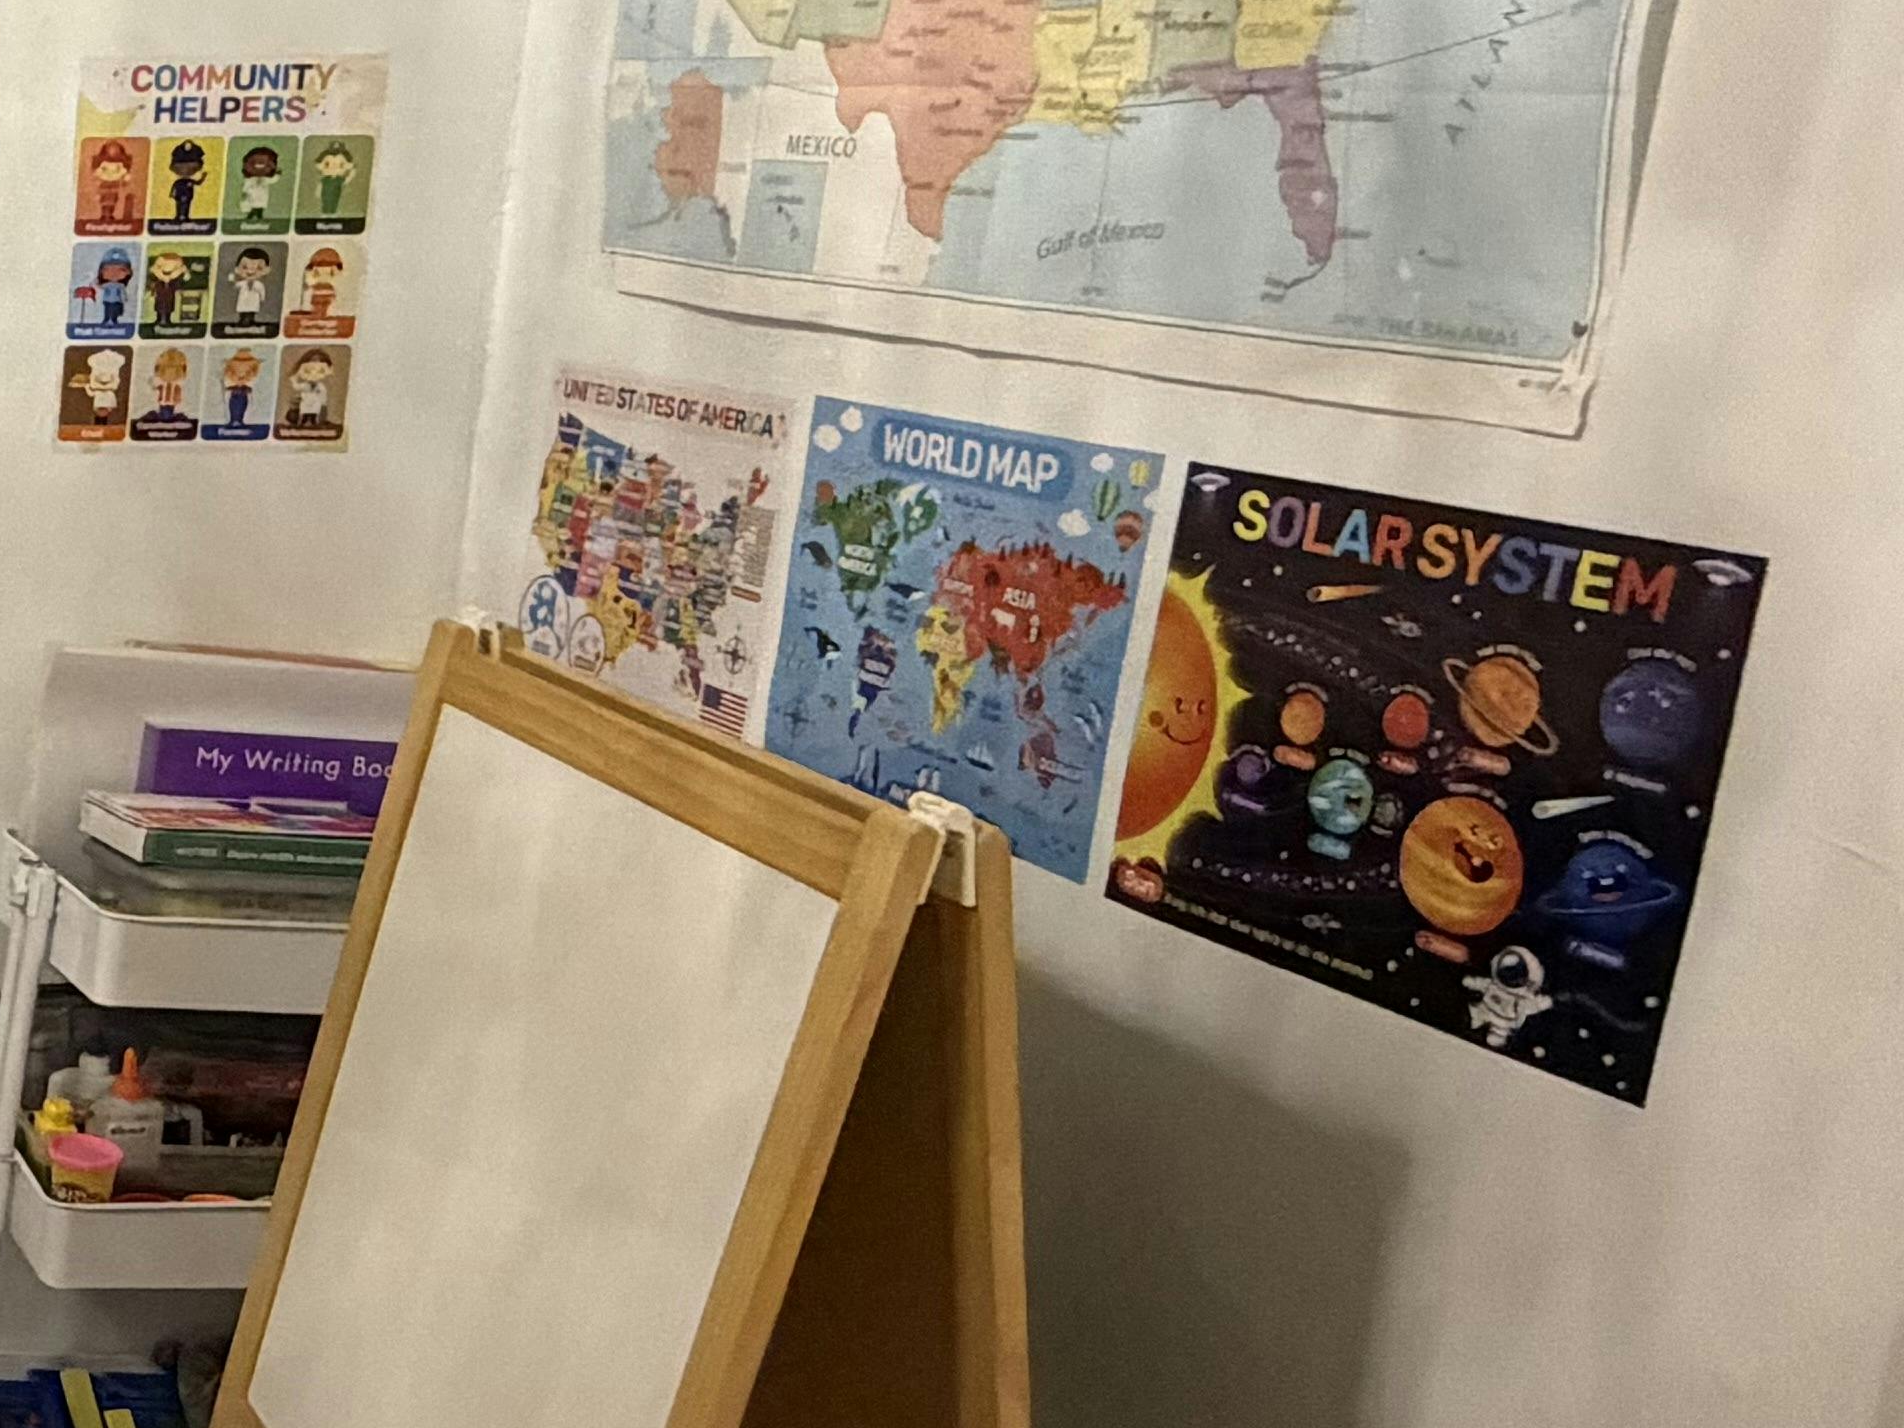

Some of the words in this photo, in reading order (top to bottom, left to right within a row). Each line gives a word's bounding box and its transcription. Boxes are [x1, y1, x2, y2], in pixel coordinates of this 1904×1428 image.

[131, 63, 337, 93] COMMUNITY
[154, 96, 307, 124] HELPERS
[786, 134, 858, 158] MEXICO
[1037, 235, 1080, 260] Gulf
[1078, 227, 1094, 250] of
[1099, 220, 1166, 250] Mexico
[564, 378, 616, 406] UNITED
[617, 387, 675, 418] STATES
[677, 398, 699, 421] OF
[699, 402, 773, 438] AMERICA
[884, 423, 983, 479] WORLD
[986, 443, 1060, 493] MAP
[1233, 489, 1414, 571] SOLAR
[1416, 523, 1678, 624] SYSTEM
[1002, 587, 1036, 610] ASIA
[196, 746, 234, 775] My
[245, 749, 341, 781] Writing
[352, 756, 393, 778] Boo
